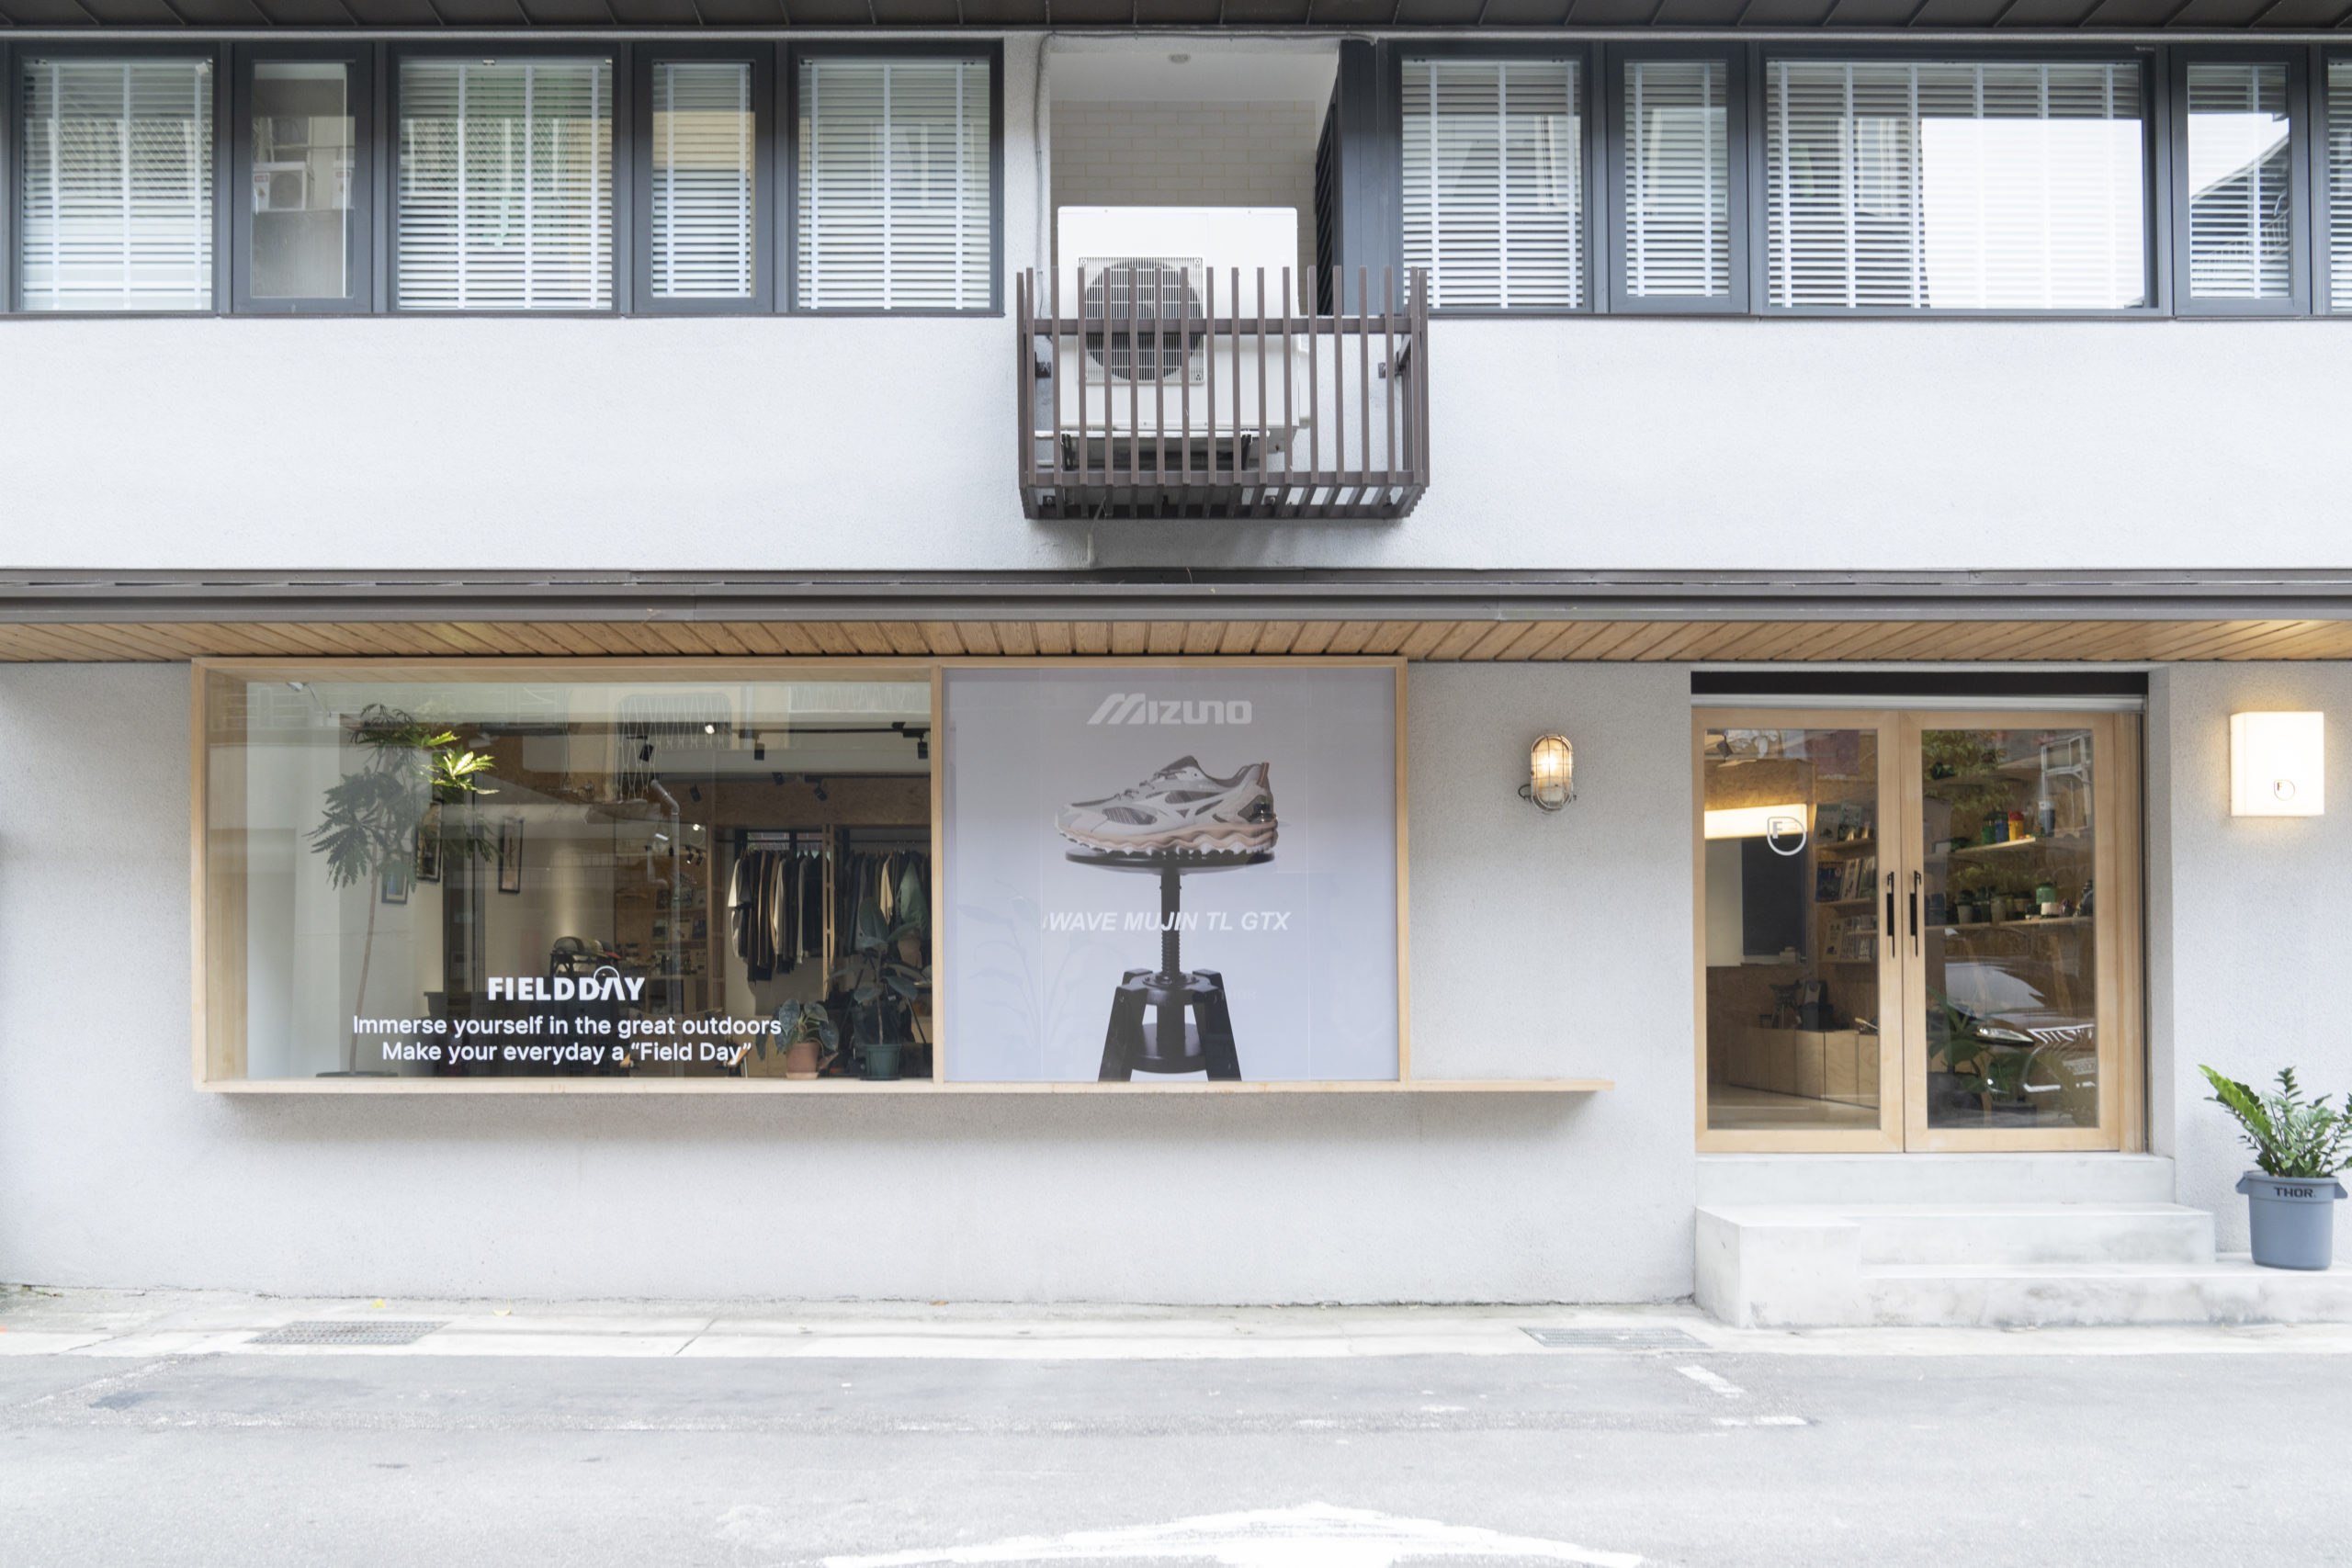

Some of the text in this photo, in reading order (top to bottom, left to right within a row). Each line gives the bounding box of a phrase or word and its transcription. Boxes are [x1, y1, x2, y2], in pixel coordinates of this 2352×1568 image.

[1049, 912, 1292, 931] WAVE MUJIN TL GTX
[353, 1015, 782, 1039] Immerse yourself in the great outdoors
[382, 1042, 441, 1060] Make
[448, 1045, 497, 1065] your
[503, 1042, 605, 1065] everyday
[612, 1045, 624, 1060] a
[630, 1042, 692, 1061] “Field
